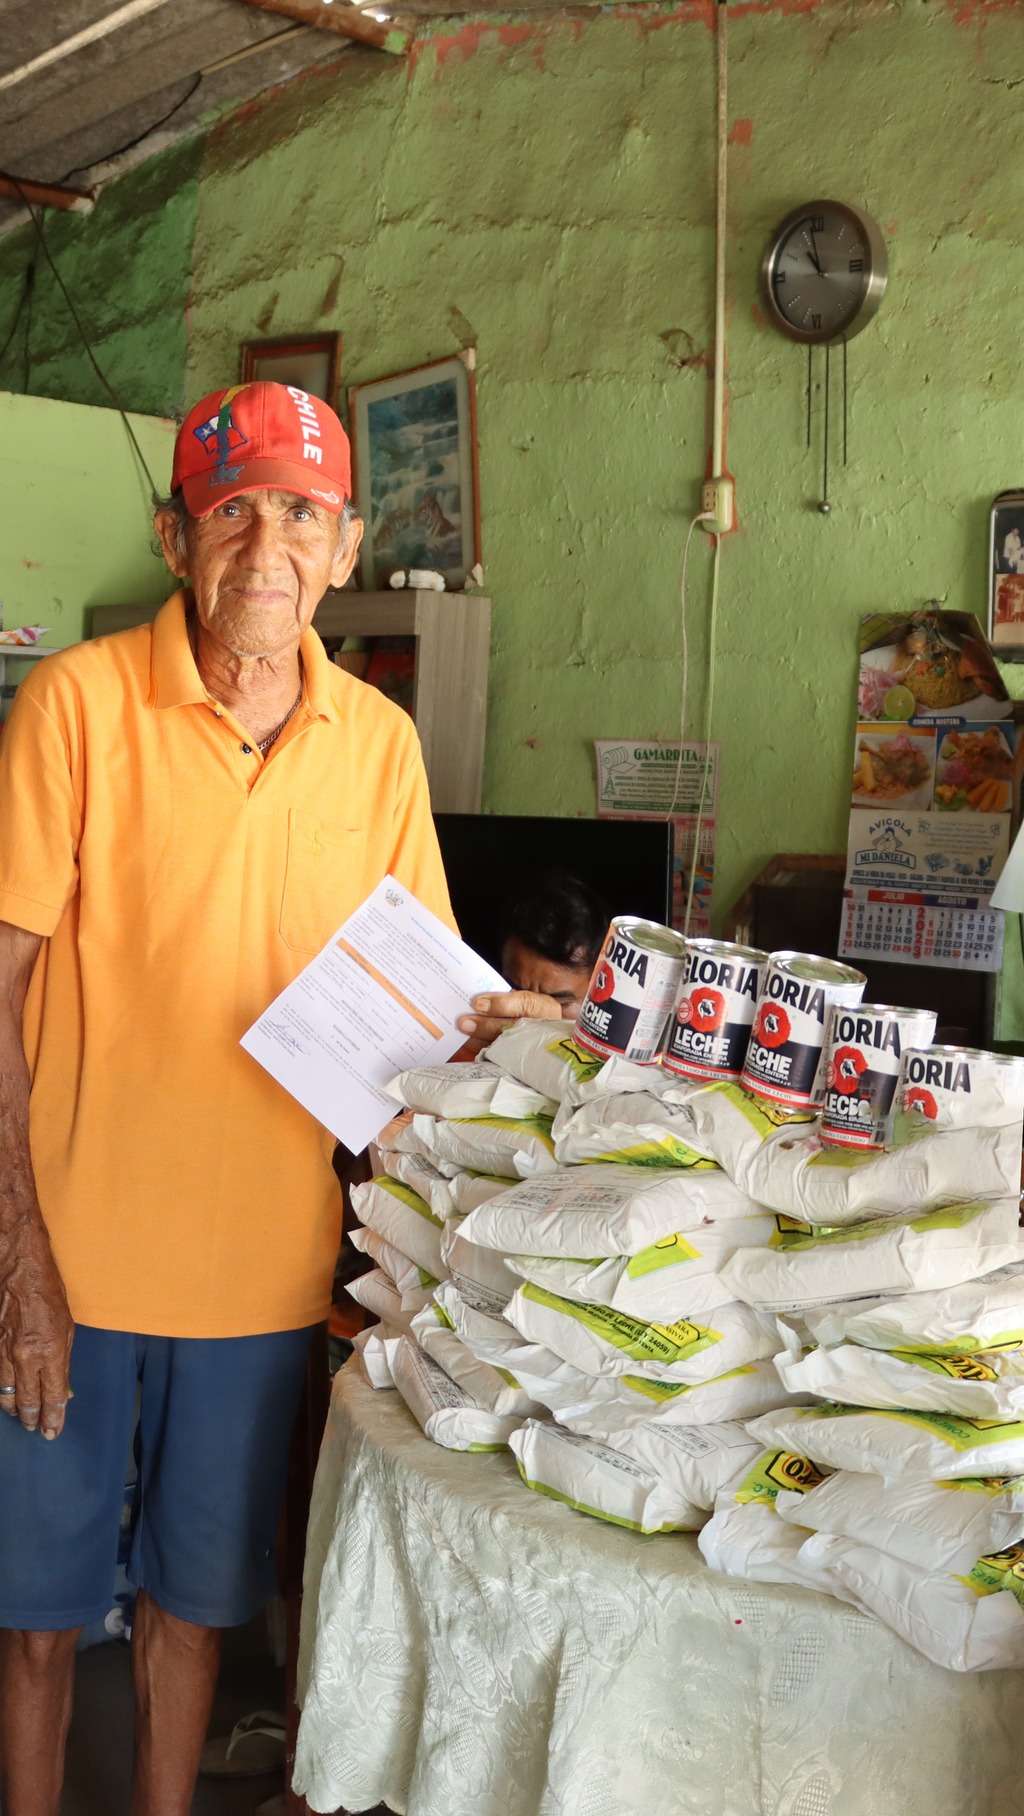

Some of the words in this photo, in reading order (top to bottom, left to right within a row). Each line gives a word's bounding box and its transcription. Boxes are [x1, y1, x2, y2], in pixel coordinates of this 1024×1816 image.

[287, 386, 323, 465] CHILE
[869, 817, 912, 837] AVICOLA
[860, 853, 870, 863] MI
[871, 852, 911, 866] DANIELA
[883, 891, 905, 900] JULIO
[938, 896, 967, 905] AGOSTO
[913, 907, 925, 958] 2023
[604, 935, 649, 989] ORIA
[682, 953, 759, 1004] GLORIA
[761, 968, 826, 1026] LORIA
[674, 1025, 731, 1056] LECHE
[833, 1014, 901, 1060] LORIA
[673, 1043, 703, 1057] EVAPORADA
[703, 1052, 728, 1062] ENTERA
[685, 1064, 700, 1074] VASO
[700, 1069, 709, 1077] DE
[709, 1071, 728, 1079] LECHE
[765, 1068, 788, 1081] ENTERA
[903, 1055, 971, 1094] LORIA
[614, 1316, 635, 1331] LECHE
[648, 1336, 669, 1354] 24059)
[665, 1325, 684, 1341] ASIVO
[638, 1340, 654, 1353] VENTA
